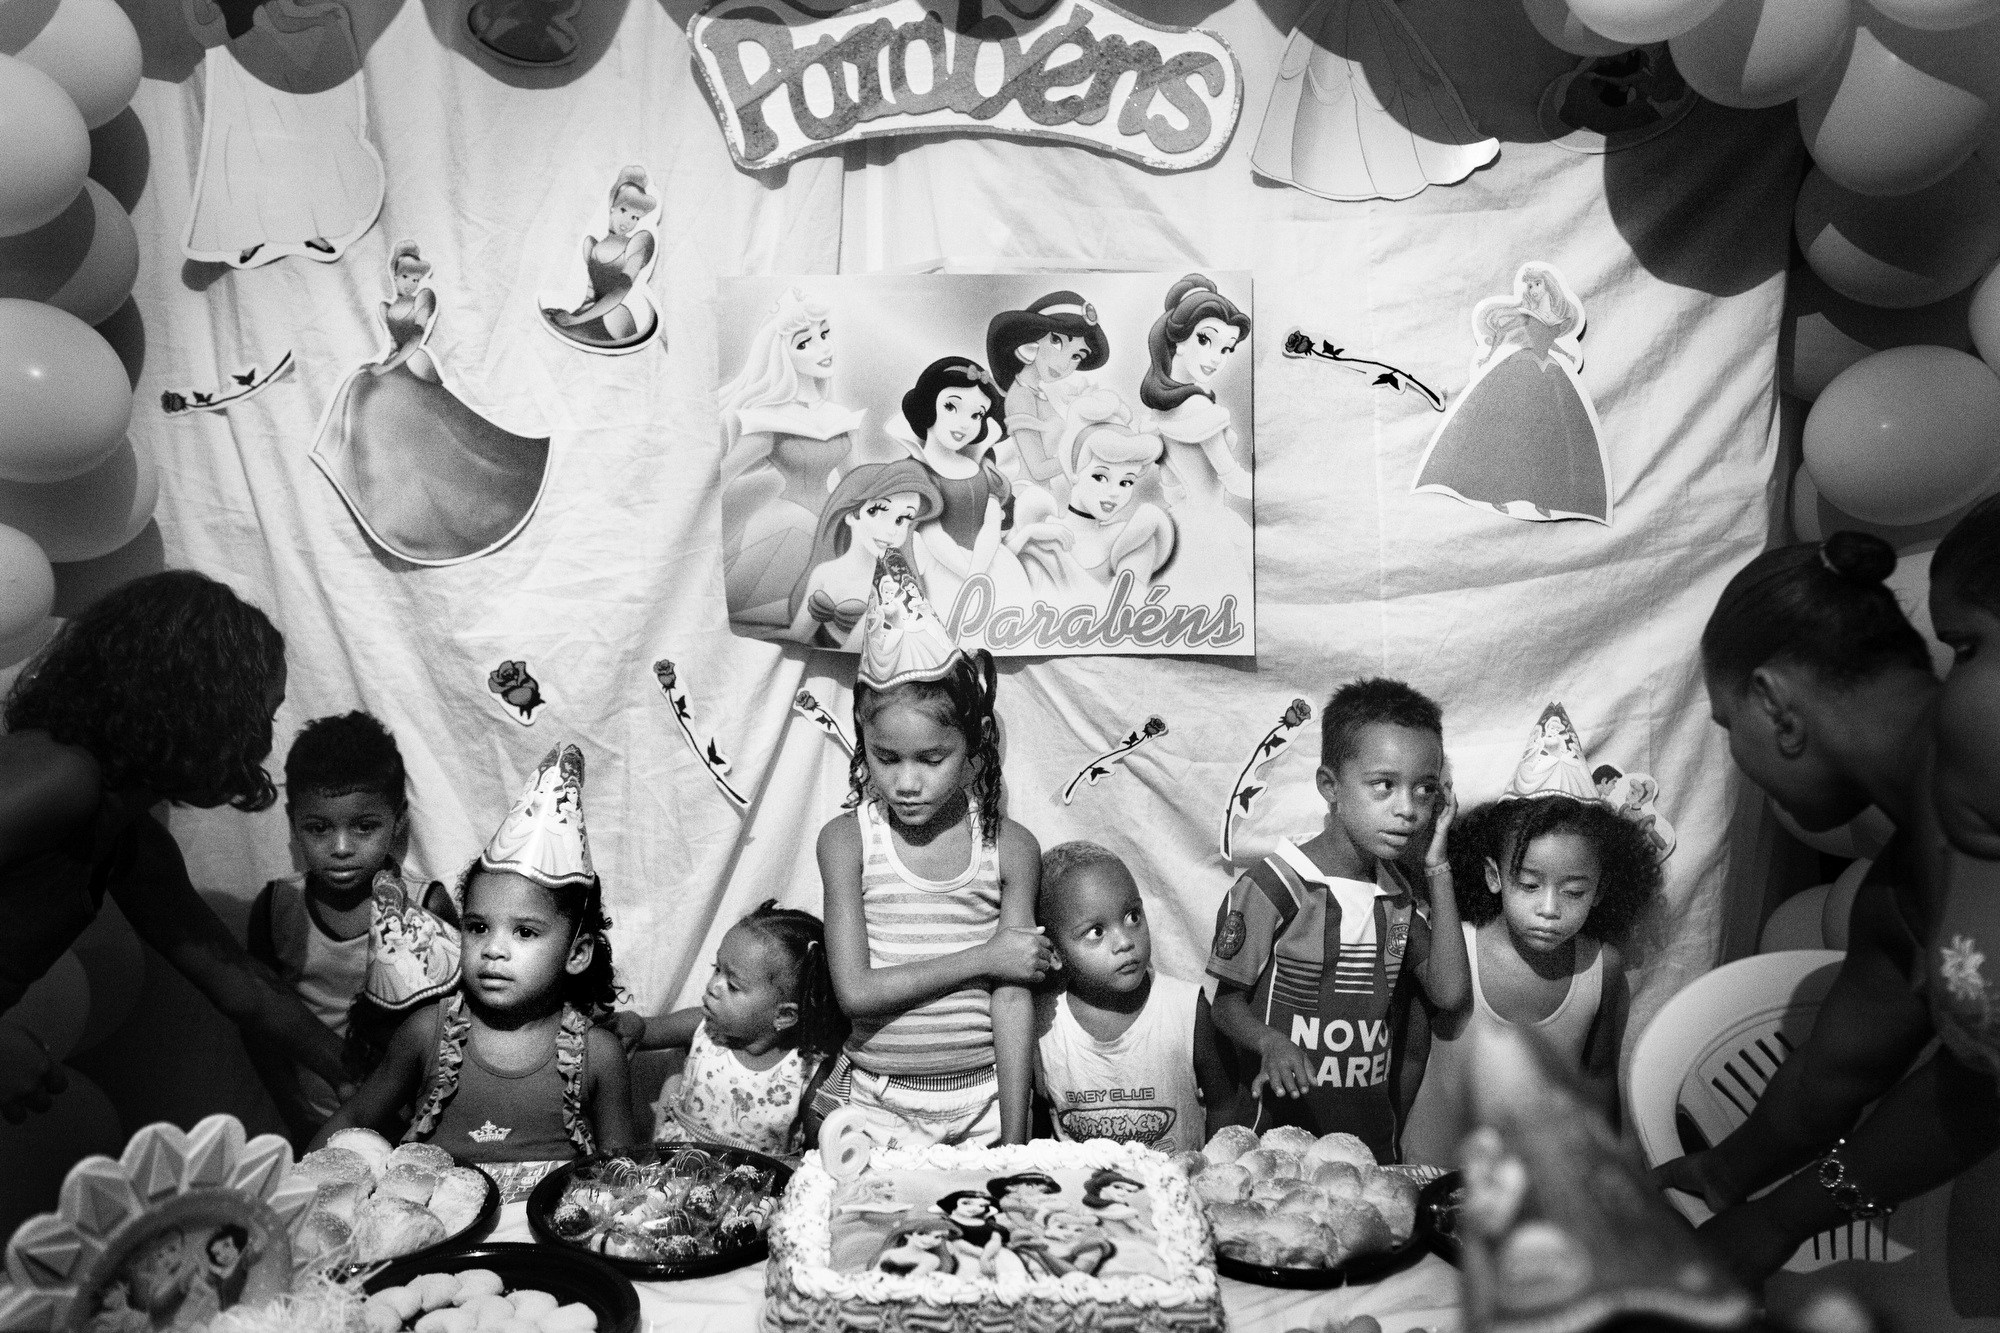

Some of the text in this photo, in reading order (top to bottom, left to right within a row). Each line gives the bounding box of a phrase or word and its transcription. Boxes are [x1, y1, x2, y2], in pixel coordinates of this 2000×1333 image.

[947, 569, 1245, 650] Parabéns
[1066, 1087, 1155, 1104] BABY CLUB
